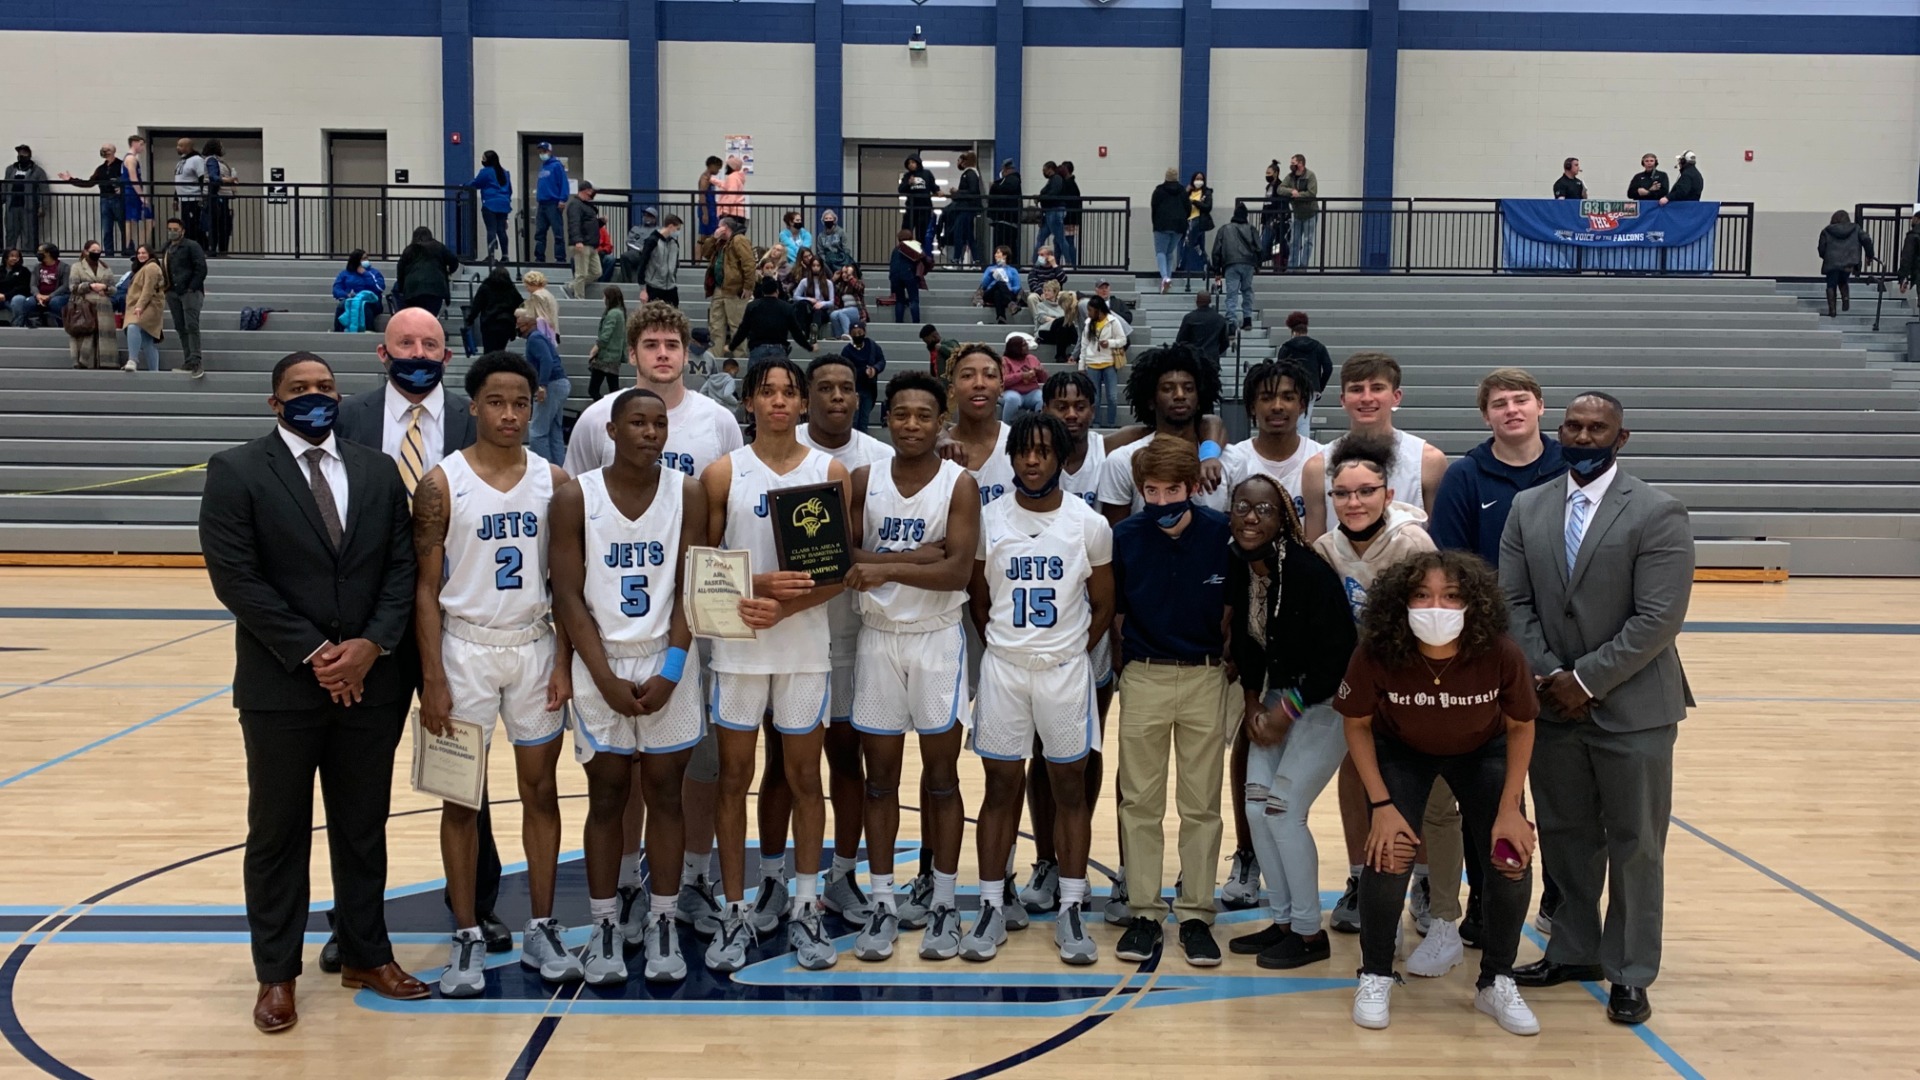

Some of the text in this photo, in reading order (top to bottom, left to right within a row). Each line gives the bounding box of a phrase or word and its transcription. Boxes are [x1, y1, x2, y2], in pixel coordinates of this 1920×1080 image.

[1590, 215, 1611, 229] THE
[1575, 233, 1594, 241] VOICE
[1613, 233, 1644, 242] FALCONS
[688, 361, 708, 375] M
[477, 511, 538, 541] JETS
[878, 516, 926, 542] JETS
[604, 541, 664, 568] JETS
[808, 548, 843, 557] BASKETBALL
[495, 546, 523, 590] 2
[1006, 556, 1063, 580] JETS
[620, 575, 651, 618] 5
[1012, 587, 1058, 628] 15
[1388, 688, 1500, 709] Bet On Yourself
